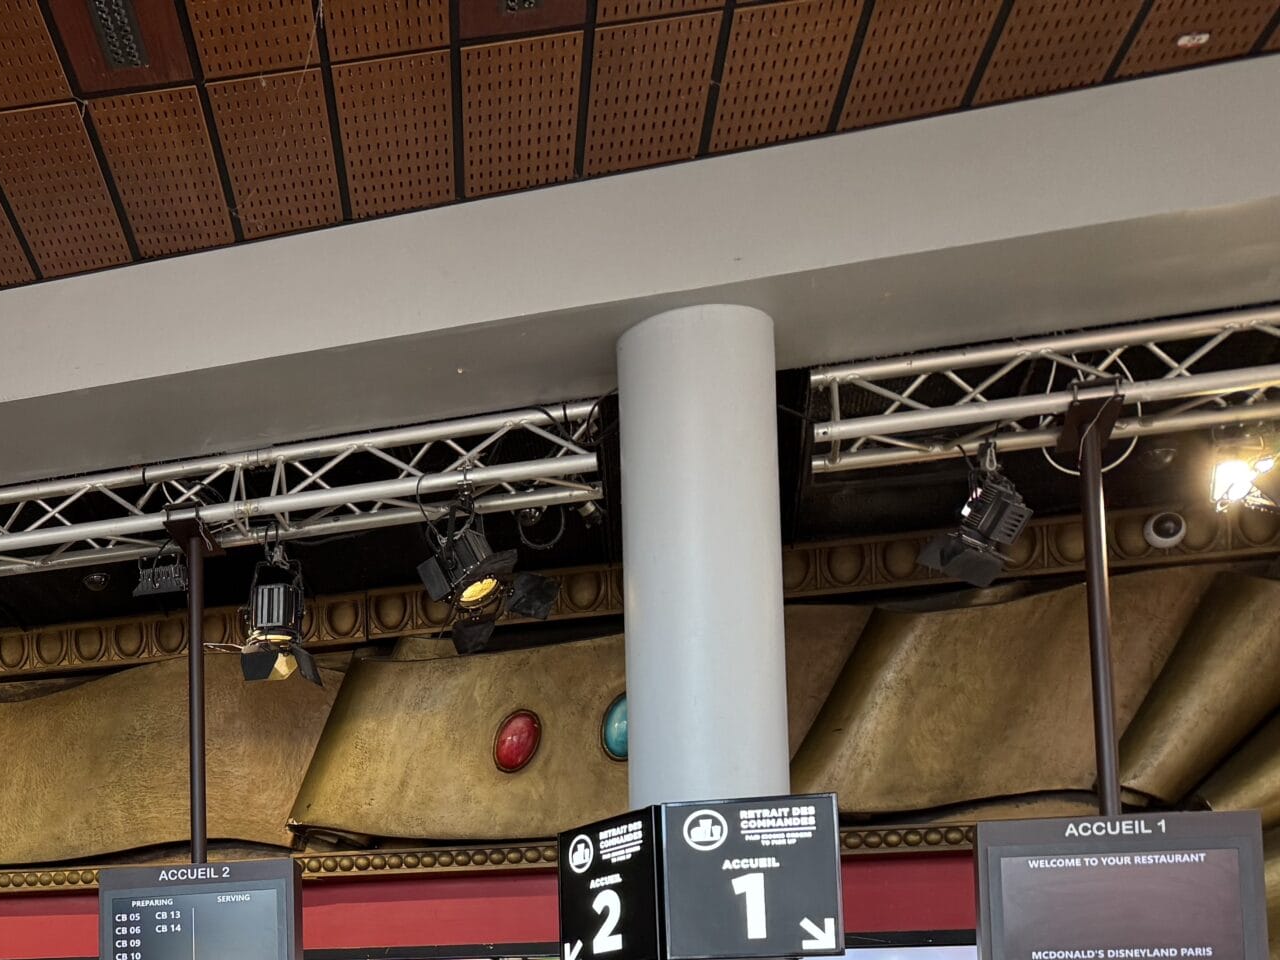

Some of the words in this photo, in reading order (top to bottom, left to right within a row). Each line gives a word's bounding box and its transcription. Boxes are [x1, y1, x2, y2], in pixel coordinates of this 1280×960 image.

[740, 807, 790, 819] RETRAIT
[791, 806, 815, 817] DES
[740, 816, 816, 829] COMMANDES
[1065, 820, 1152, 837] ACCUEIL
[1157, 819, 1167, 833] 1
[722, 857, 780, 870] ACCUEIL
[1028, 857, 1081, 868] WELCOME
[1083, 857, 1098, 867] TO
[1101, 856, 1131, 866] YOUR
[1134, 853, 1206, 864] RESTAURANT
[158, 868, 219, 881] ACCUEIL
[222, 867, 230, 878] 2
[590, 873, 622, 889] ACCUEIL
[131, 898, 173, 907] PREPARING
[217, 894, 250, 903] SERVING
[731, 872, 767, 940] 1
[115, 914, 127, 922] CB
[129, 913, 140, 921] 05
[170, 911, 181, 919] 13
[592, 889, 622, 954] 2
[115, 927, 127, 935] CB
[129, 926, 141, 934] 06
[170, 924, 181, 932] 14
[115, 940, 127, 948] CB
[129, 939, 141, 947] 09
[115, 953, 127, 960] CB
[130, 953, 142, 960] 10
[1031, 950, 1105, 960] MCDONALD'S
[1107, 948, 1177, 958] DISNEYLAND
[1181, 947, 1213, 957] PARIS
